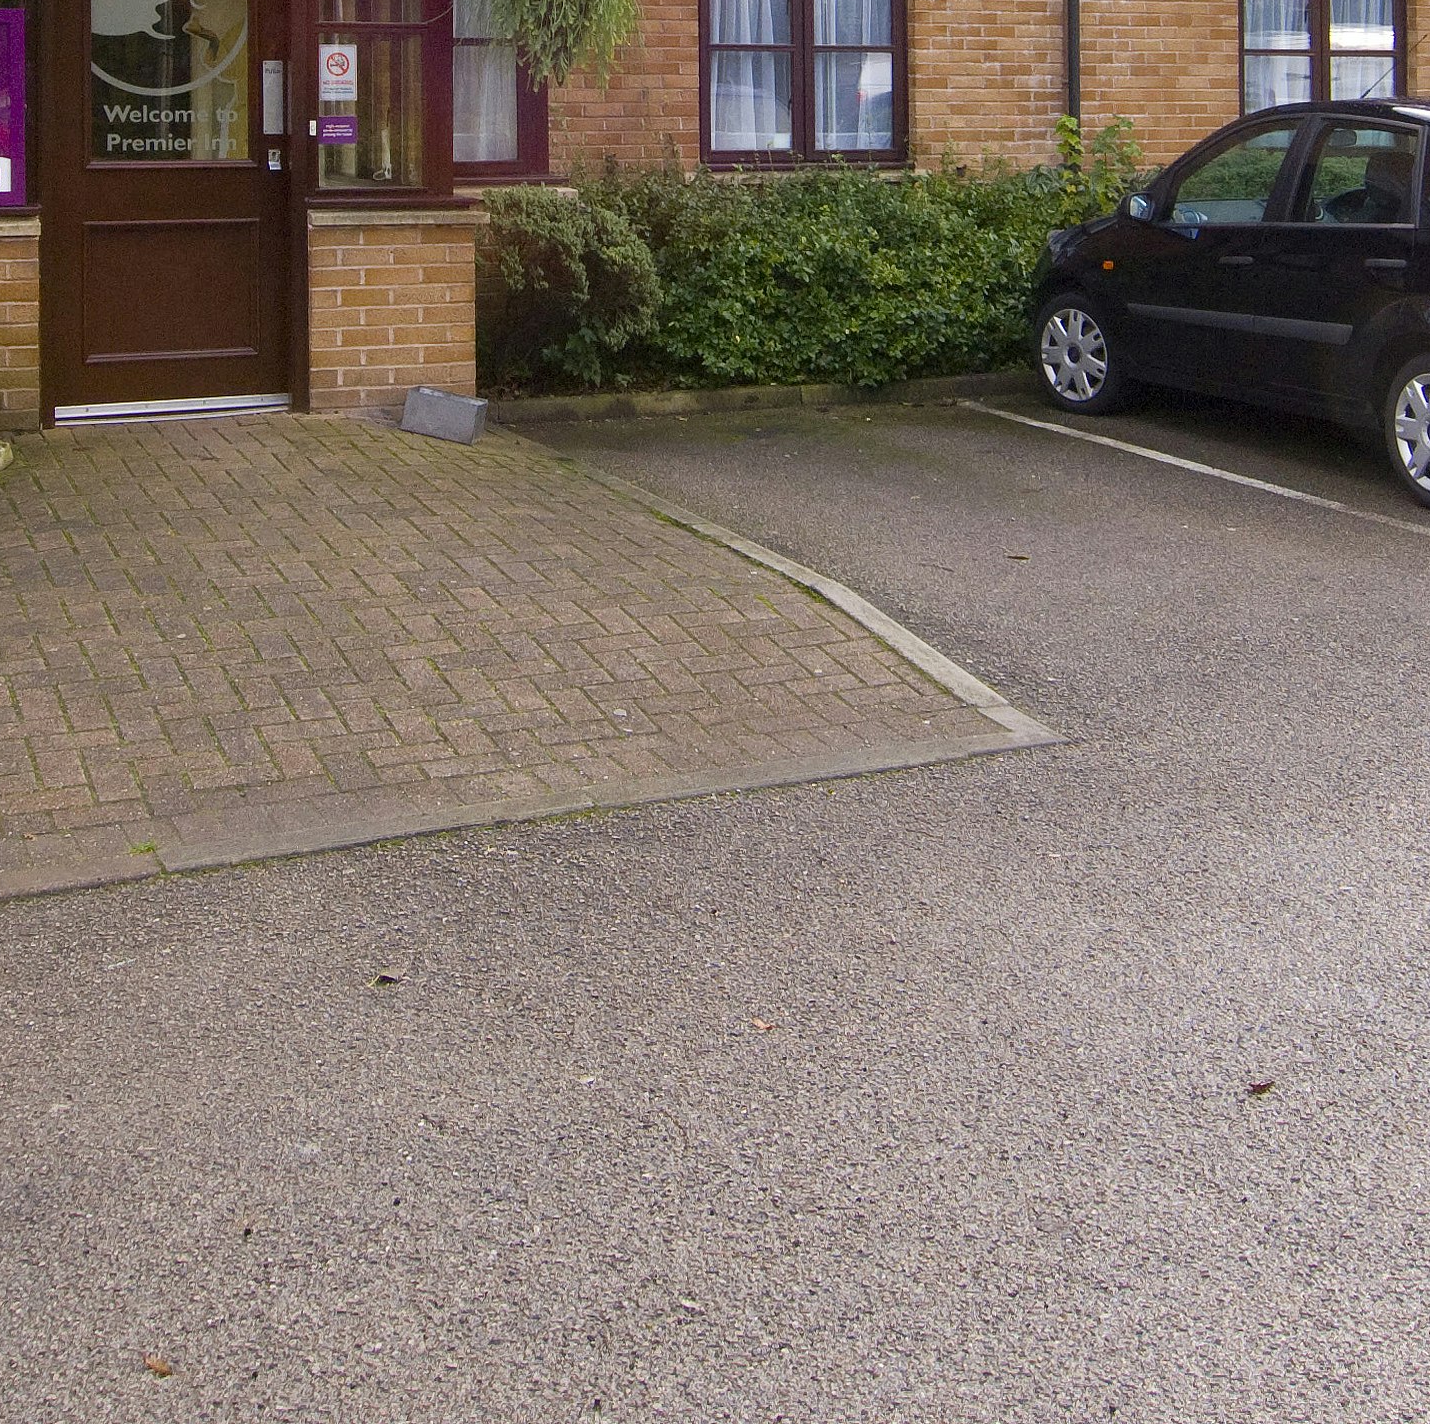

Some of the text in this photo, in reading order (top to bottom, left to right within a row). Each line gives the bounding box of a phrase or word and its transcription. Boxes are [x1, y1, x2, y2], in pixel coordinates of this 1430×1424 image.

[103, 104, 238, 123] Welcome to
[106, 133, 237, 152] Premier Inn
